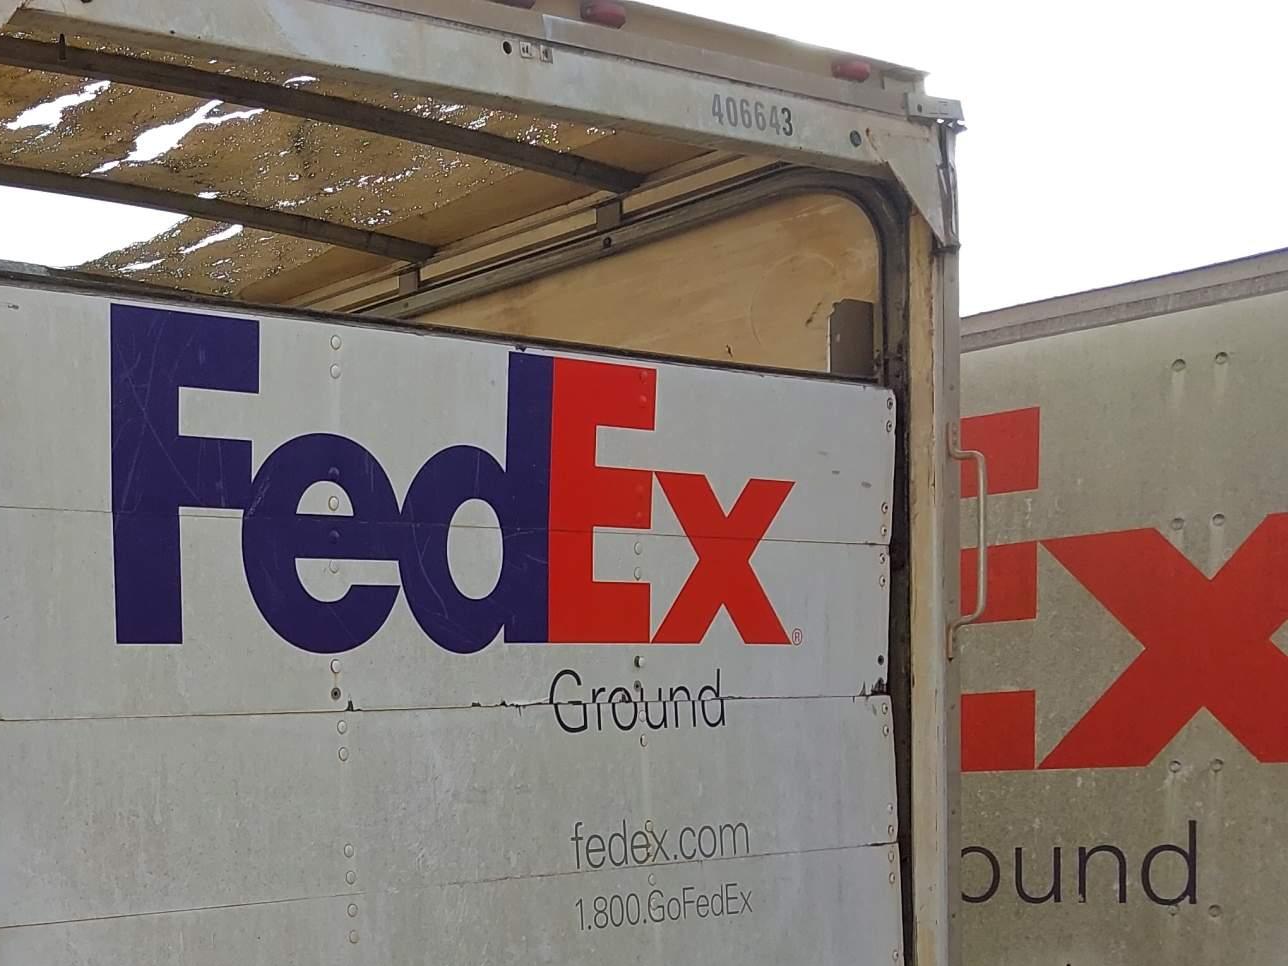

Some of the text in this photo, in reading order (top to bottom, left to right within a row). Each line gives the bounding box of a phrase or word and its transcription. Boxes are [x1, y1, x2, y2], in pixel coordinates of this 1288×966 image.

[711, 93, 793, 136] 406643
[110, 303, 796, 654] FedEx
[549, 668, 726, 733] Ground
[570, 819, 751, 870] fedex.com
[575, 883, 753, 931] 1.800.GoFedEx
